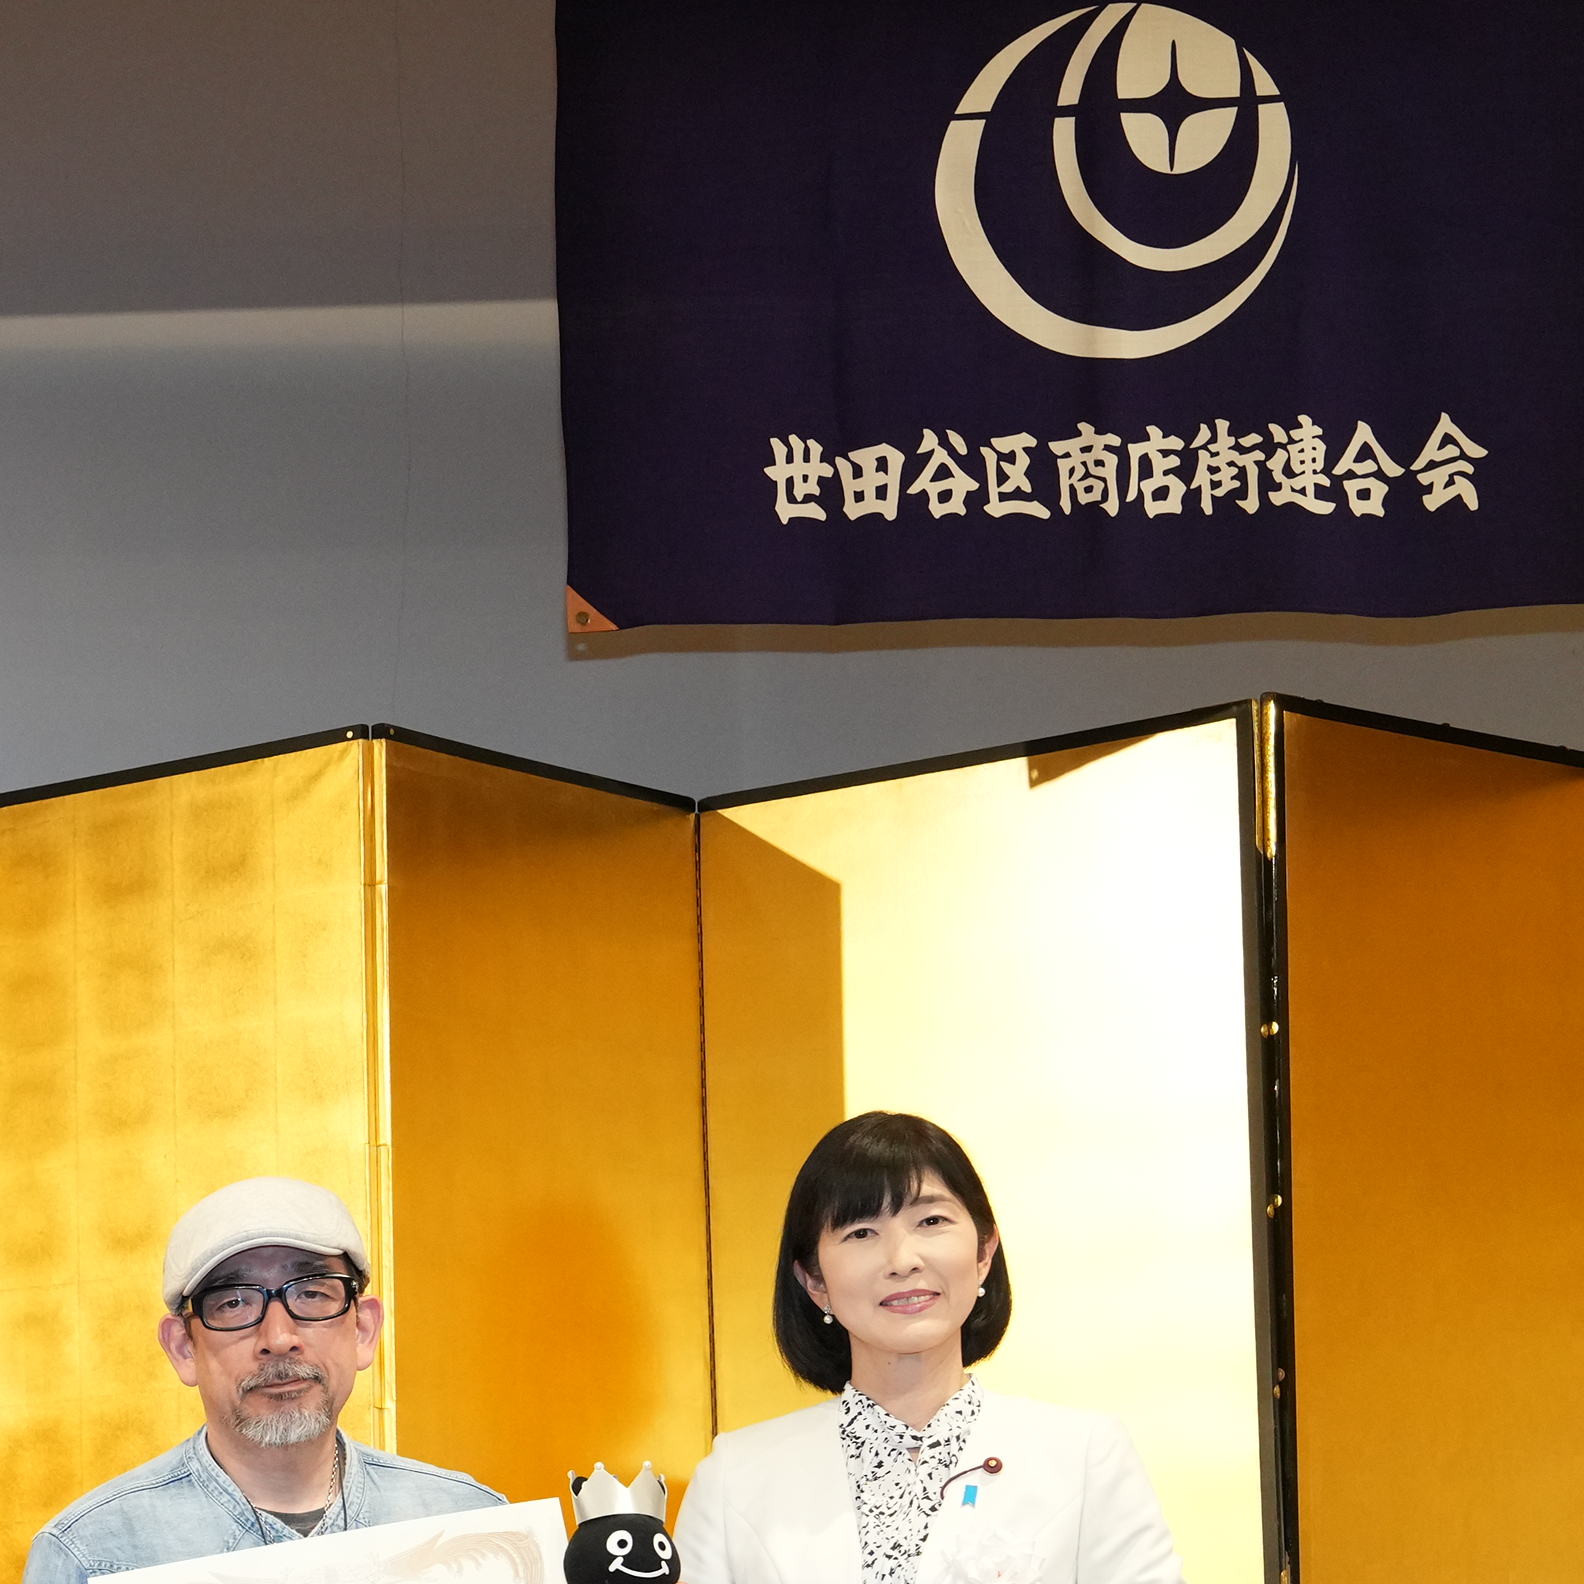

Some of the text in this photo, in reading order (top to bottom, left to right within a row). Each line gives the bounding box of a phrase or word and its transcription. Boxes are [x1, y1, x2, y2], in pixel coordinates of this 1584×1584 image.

[763, 412, 1489, 524] 世田谷区商店街連合会
